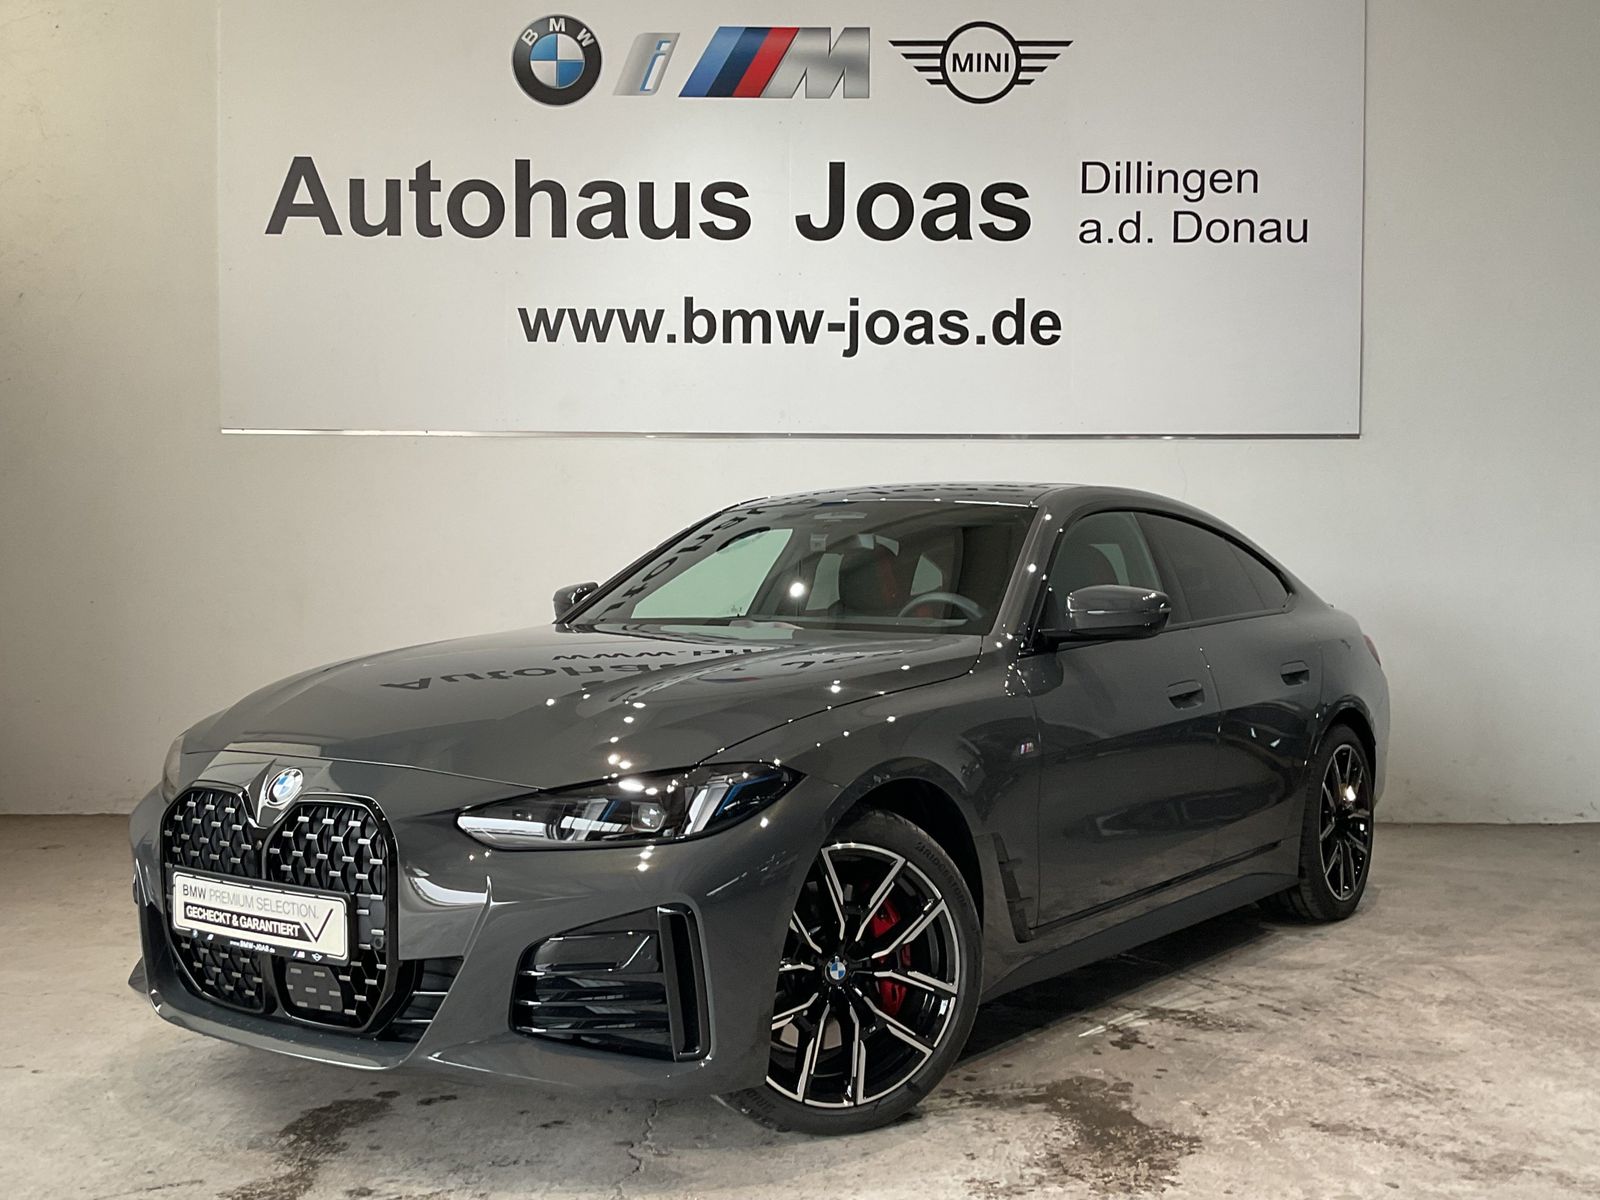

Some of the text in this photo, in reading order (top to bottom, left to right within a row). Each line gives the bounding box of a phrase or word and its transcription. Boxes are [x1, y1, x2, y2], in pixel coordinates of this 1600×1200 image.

[521, 17, 595, 47] BMW
[953, 53, 1009, 73] MINI
[1081, 161, 1259, 203] Dillingen
[265, 156, 1031, 242] Autohaus Joas
[1079, 210, 1308, 243] a.d. Donau
[517, 296, 1062, 358] www.bmw-joas.de
[183, 884, 206, 900] BMW
[210, 888, 254, 909] PREMIUM
[186, 905, 300, 937] GECHECKT & GARANTIERT
